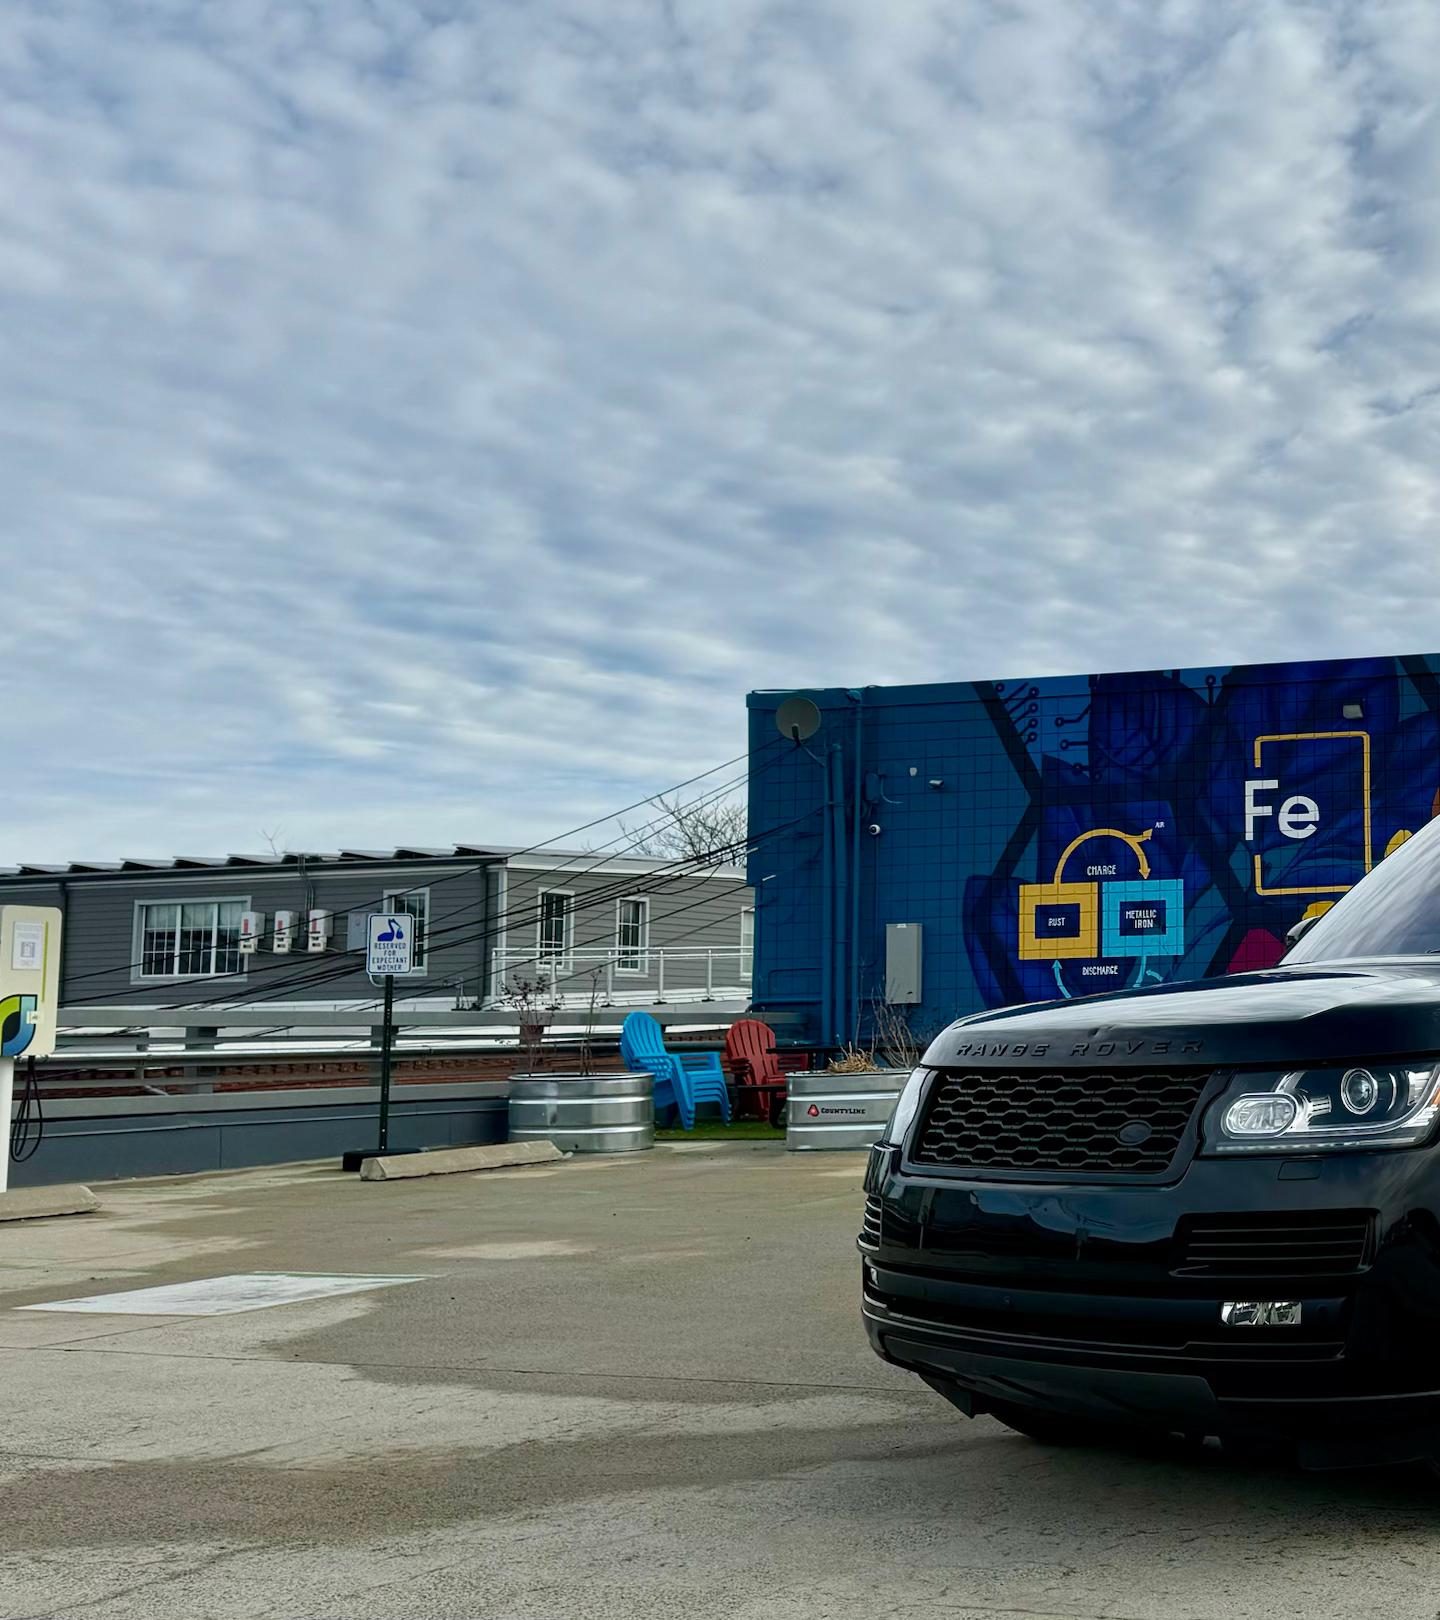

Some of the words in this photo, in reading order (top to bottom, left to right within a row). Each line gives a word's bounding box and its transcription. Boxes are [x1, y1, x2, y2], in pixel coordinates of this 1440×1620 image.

[1244, 779, 1320, 841] Fe
[1086, 864, 1117, 876] CHARGE
[1125, 909, 1158, 919] METALLIC
[1048, 917, 1066, 927] RUST
[1134, 919, 1154, 929] IRON
[1081, 965, 1119, 976] DISCHARGE
[955, 1042, 1050, 1058] RANGE
[1069, 1039, 1204, 1058] ROVER
